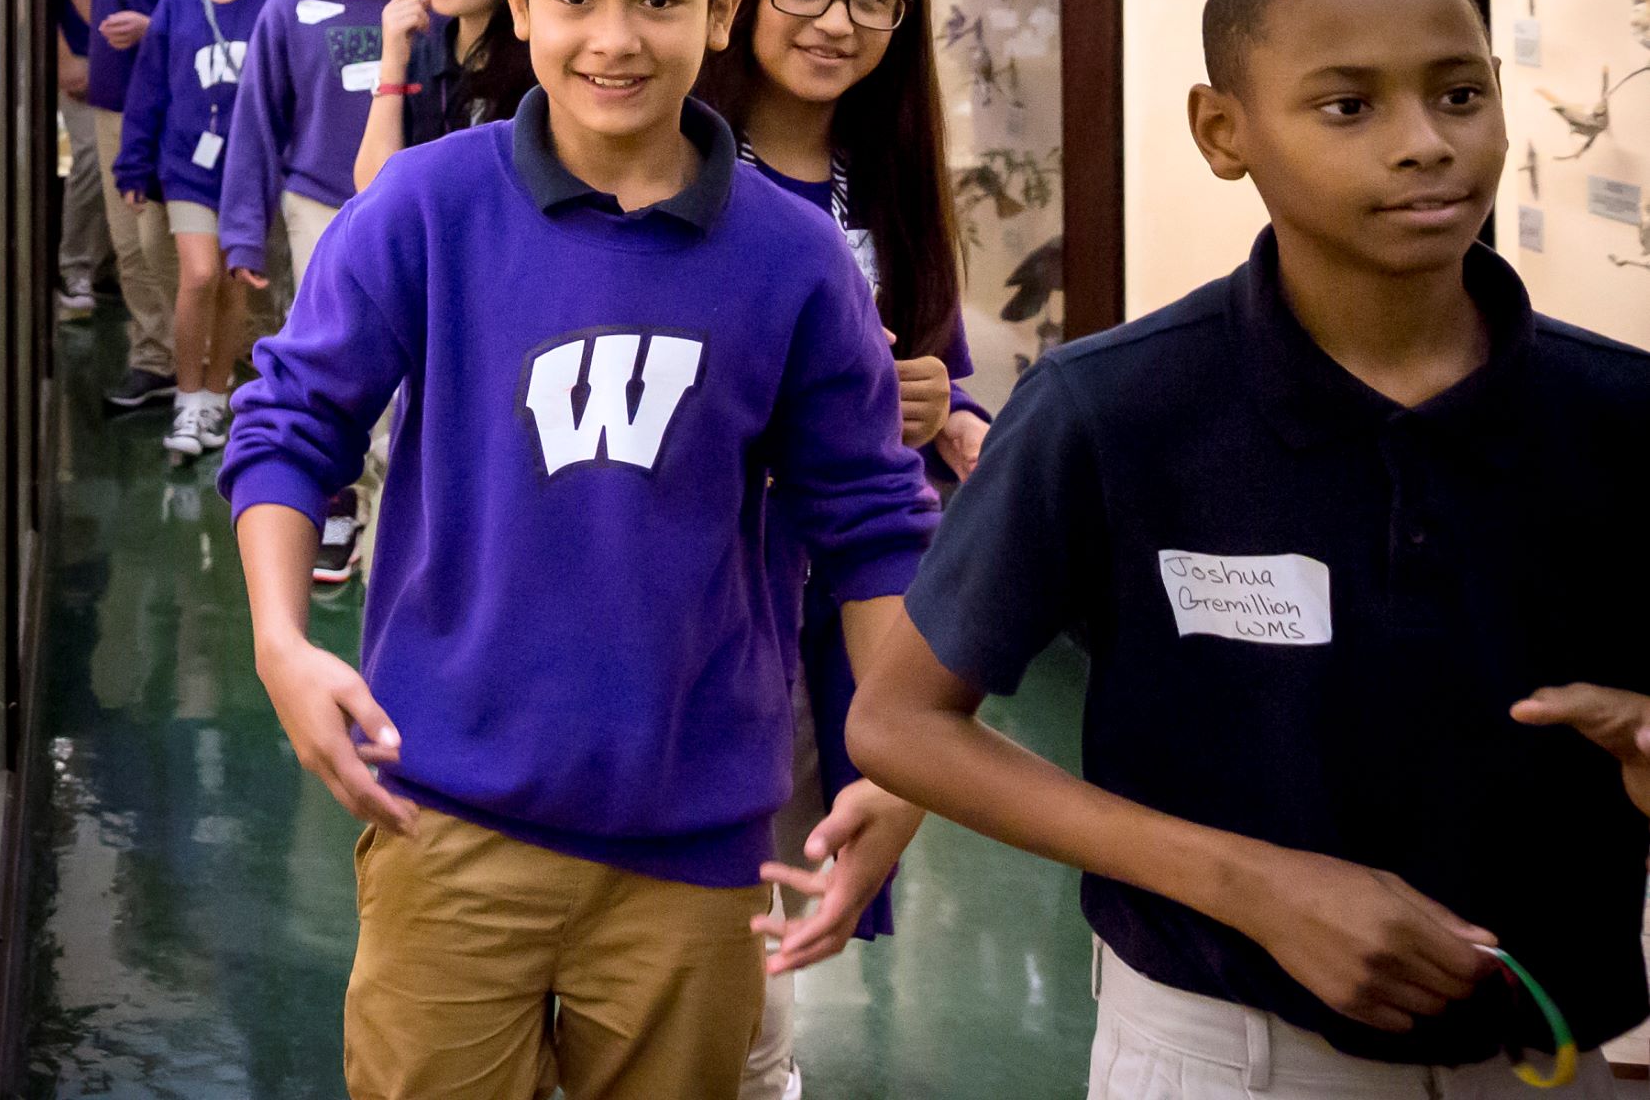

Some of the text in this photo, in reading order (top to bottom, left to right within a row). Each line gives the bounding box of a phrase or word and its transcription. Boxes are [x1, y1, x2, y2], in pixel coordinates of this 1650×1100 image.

[524, 332, 704, 477] W
[1164, 556, 1275, 587] Joshua
[1178, 586, 1301, 618] Gremillion
[1235, 620, 1306, 639] WMS
